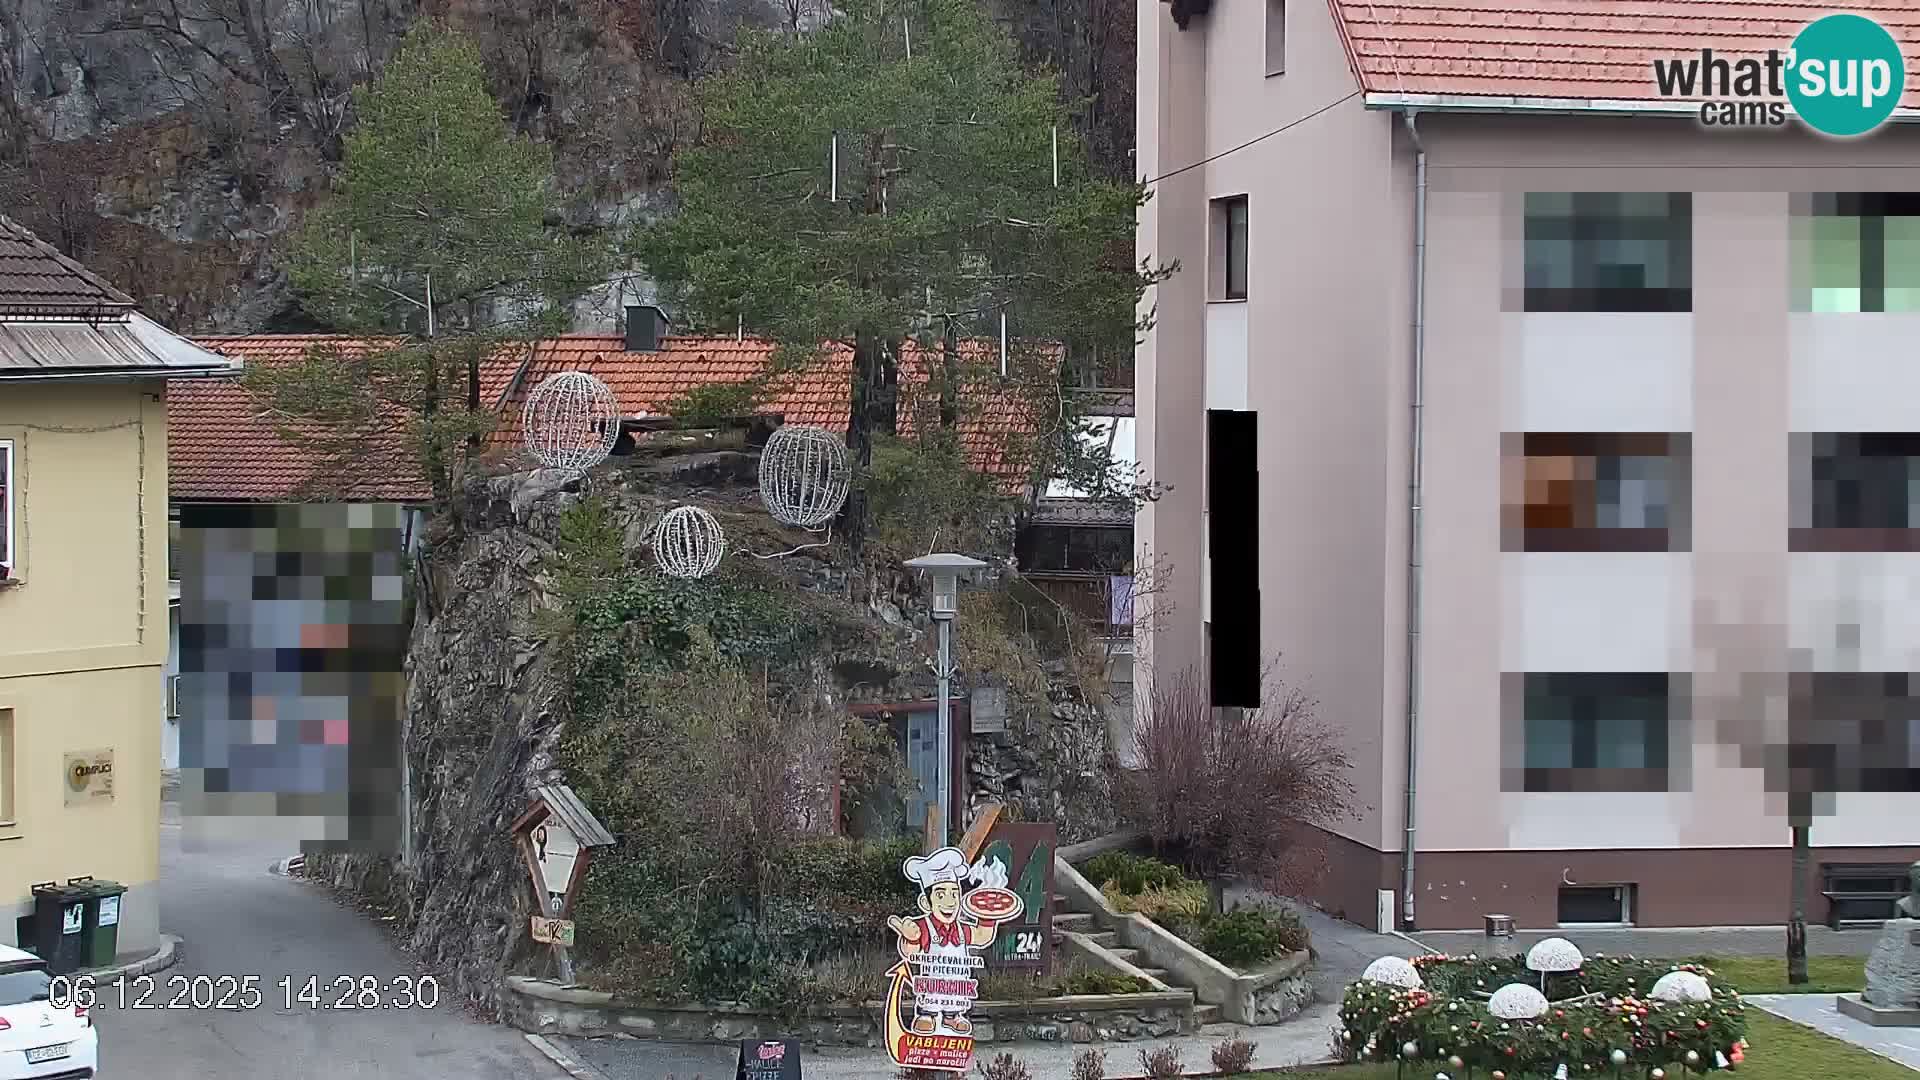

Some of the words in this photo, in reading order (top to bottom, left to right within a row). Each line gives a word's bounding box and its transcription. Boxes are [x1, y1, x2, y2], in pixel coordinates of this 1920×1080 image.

[922, 965, 930, 973] IN
[932, 966, 970, 976] PICERIJA
[914, 978, 977, 998] KURNIK
[906, 1036, 973, 1051] VABLJENI
[940, 1049, 968, 1058] malice
